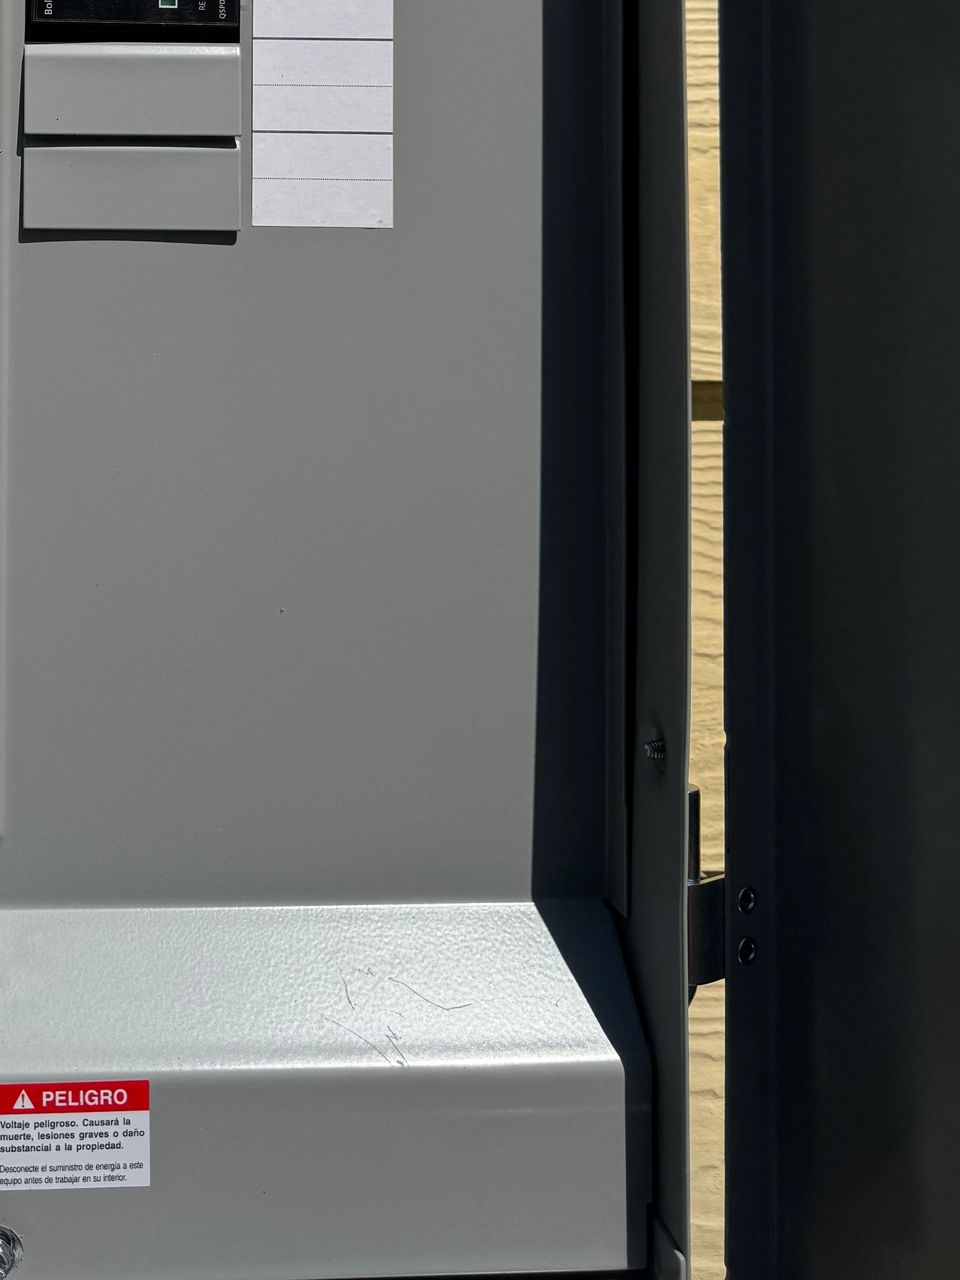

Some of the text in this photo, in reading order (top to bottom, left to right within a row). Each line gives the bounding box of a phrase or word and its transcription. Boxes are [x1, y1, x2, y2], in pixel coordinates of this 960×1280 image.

[42, 1088, 127, 1107] PELIGRO
[0, 1120, 30, 1129] Voltaje
[34, 1119, 78, 1129] peligroso.
[83, 1117, 119, 1127] Causará
[38, 1132, 75, 1140] lesiones
[79, 1132, 109, 1140] graves
[123, 1129, 145, 1137] daño
[0, 1144, 51, 1153] substancial
[65, 1143, 72, 1151] la
[76, 1142, 123, 1152] propiedad.
[0, 1164, 38, 1173] Desconecte
[41, 1164, 47, 1172] el
[49, 1163, 83, 1172] suministro
[85, 1162, 94, 1170] de
[95, 1161, 121, 1171] energía
[0, 1177, 22, 1186] equipo
[24, 1176, 42, 1184] antes
[45, 1175, 53, 1183] de
[55, 1174, 80, 1184] trabajar
[103, 1173, 127, 1181] interior.
